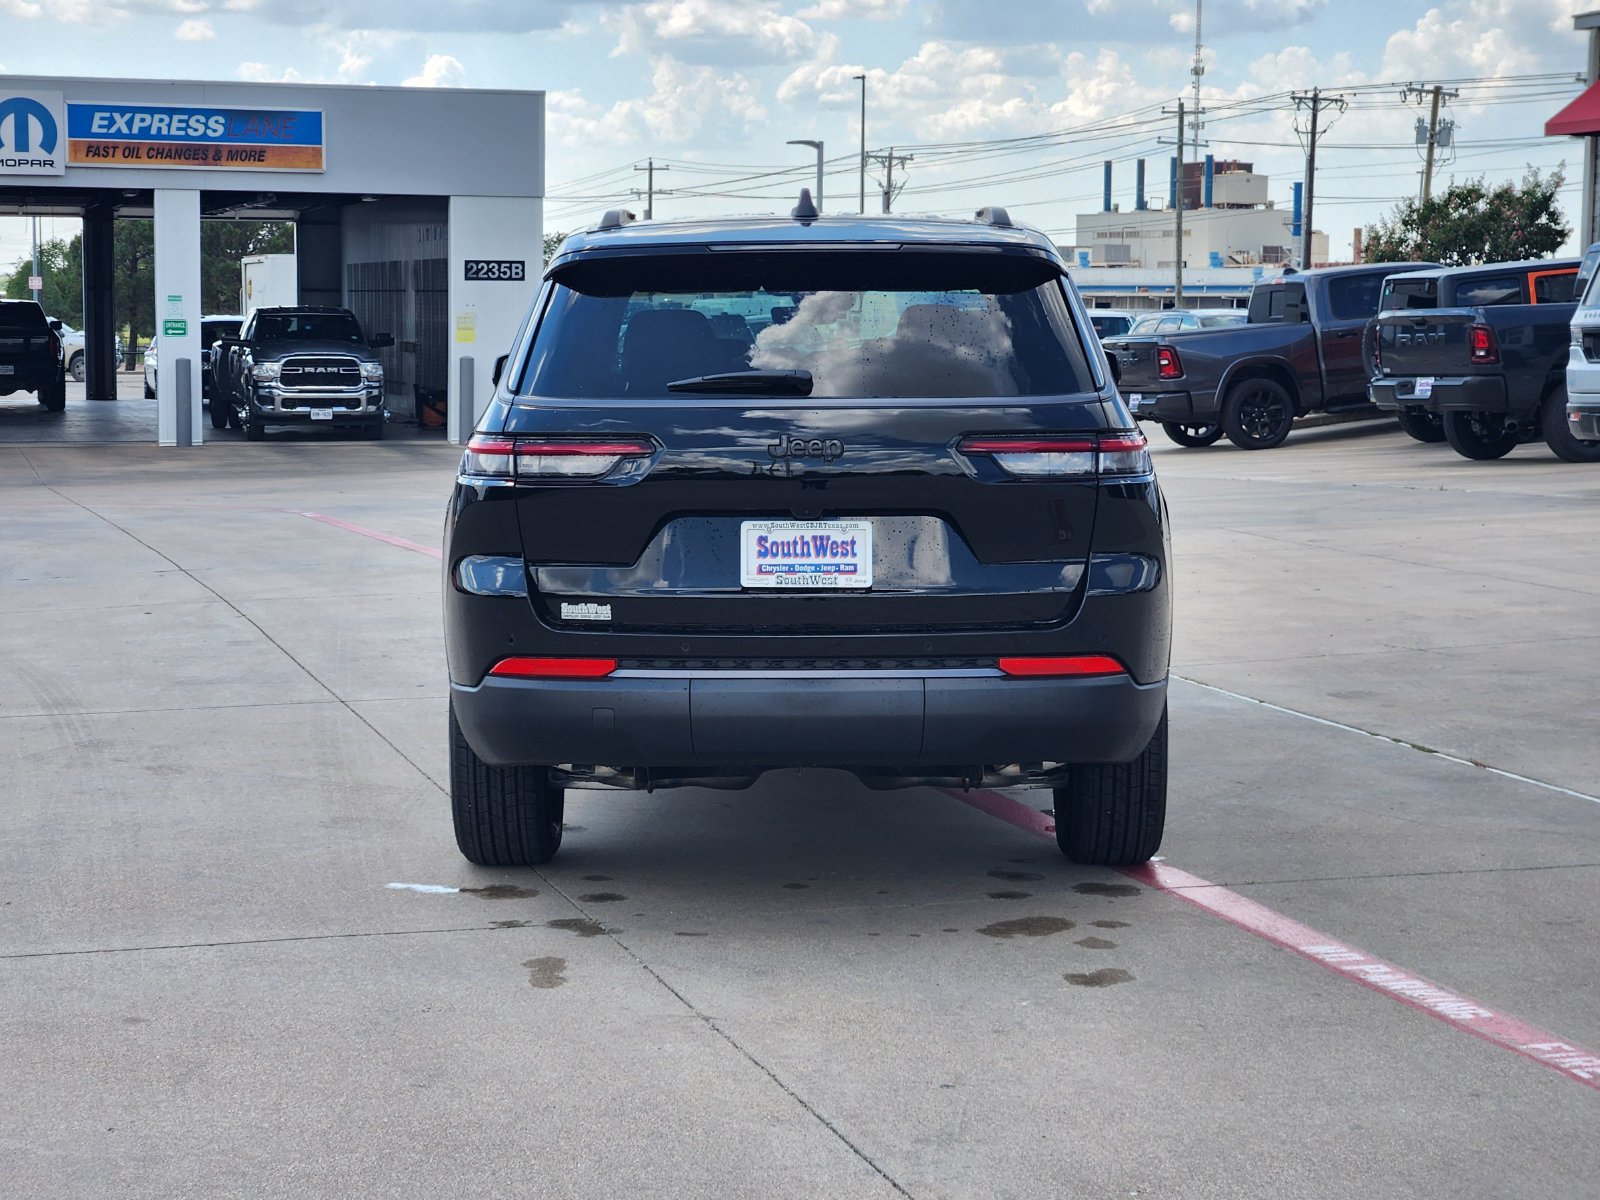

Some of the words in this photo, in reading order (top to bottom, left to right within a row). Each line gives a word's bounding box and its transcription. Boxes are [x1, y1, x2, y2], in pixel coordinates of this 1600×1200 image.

[91, 112, 225, 137] EXPRESS
[226, 113, 297, 139] LANE
[86, 145, 118, 158] FAST
[122, 146, 142, 159] OIL
[146, 147, 209, 160] CHANGES
[212, 149, 222, 162] &
[227, 150, 266, 162] MORE
[0, 159, 55, 168] OPAR
[466, 262, 523, 279] 2235B
[768, 434, 844, 463] Jeep
[756, 535, 857, 559] SouthWest
[761, 565, 789, 573] Chrysler
[795, 565, 815, 573] Dodge
[821, 565, 836, 573] Jeep
[840, 564, 855, 572] Ram
[776, 575, 838, 585] SouthWest
